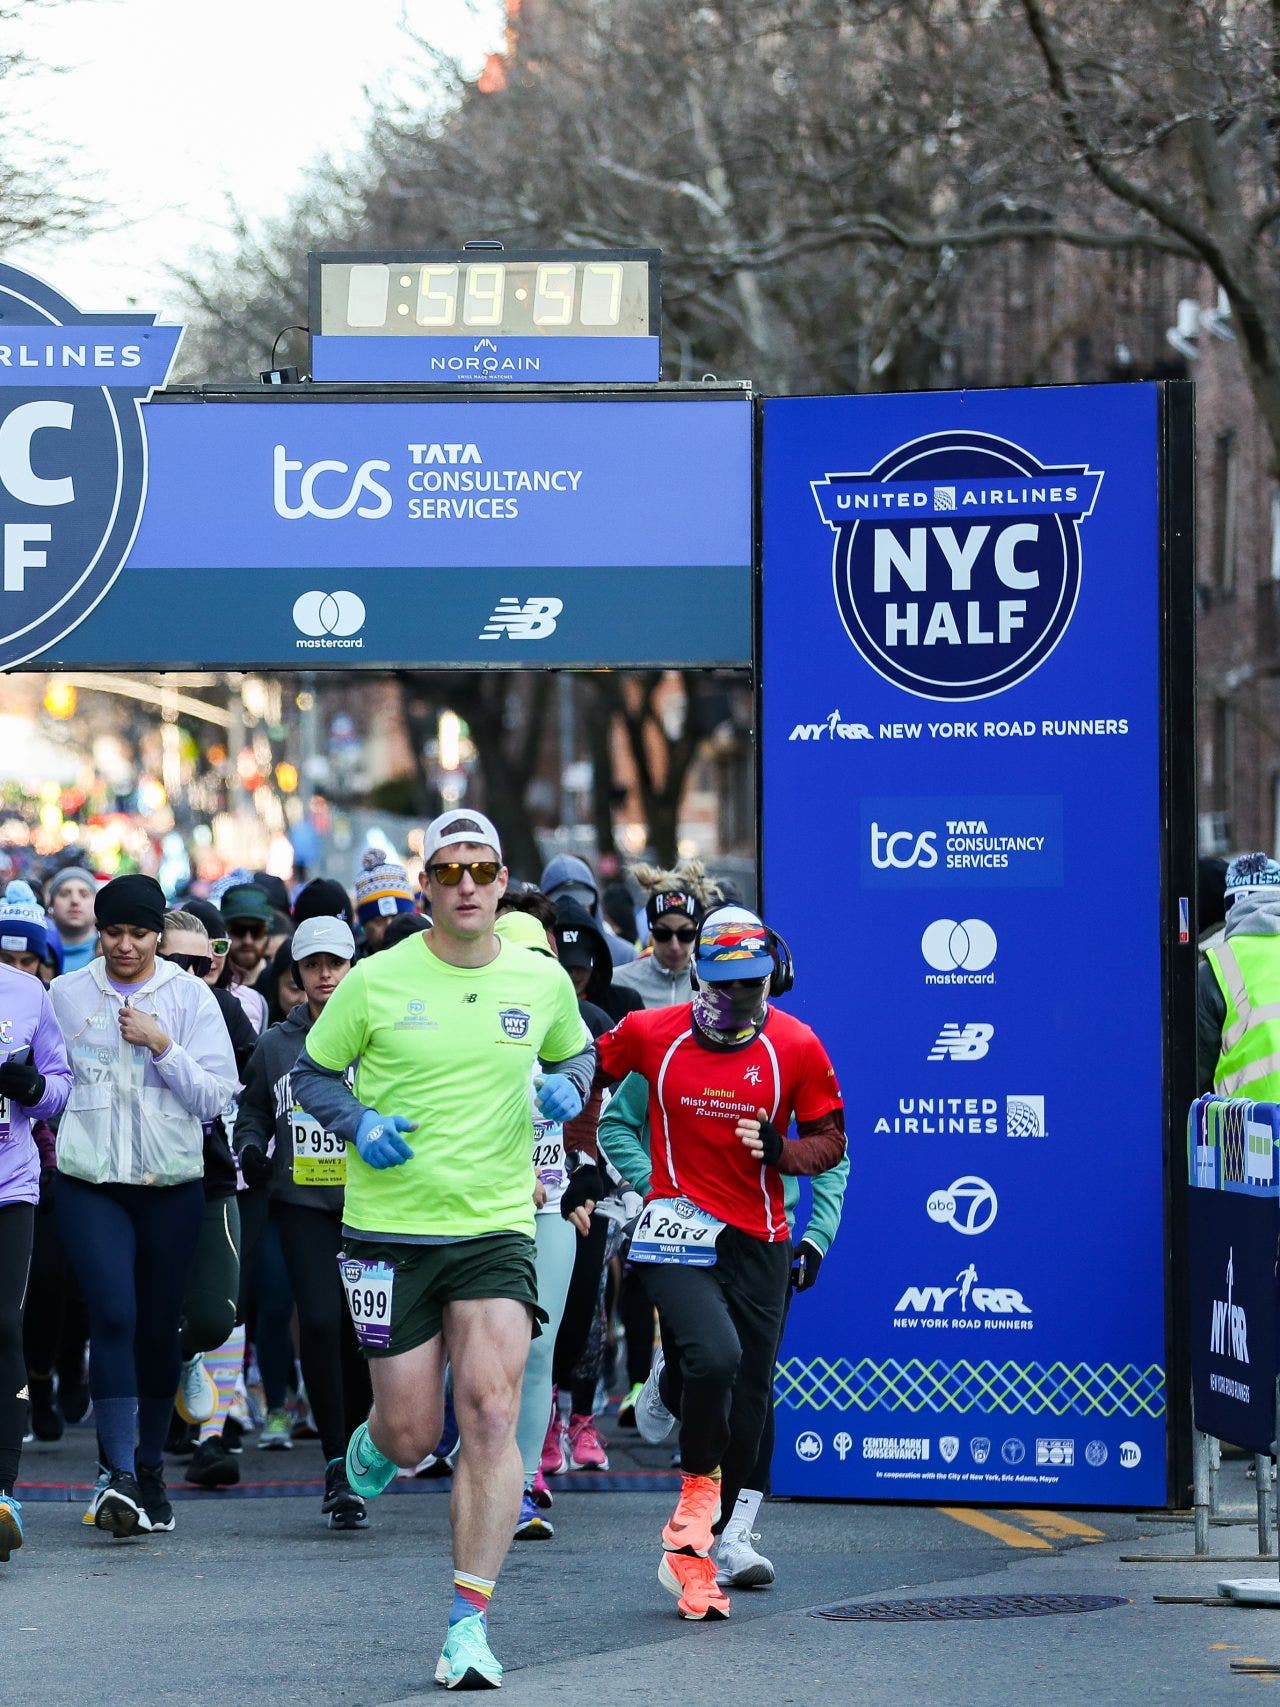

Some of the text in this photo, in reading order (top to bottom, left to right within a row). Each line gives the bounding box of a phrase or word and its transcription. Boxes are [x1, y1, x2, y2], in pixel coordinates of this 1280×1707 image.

[431, 357, 540, 371] NORQAIN
[407, 443, 482, 464] TATA
[274, 444, 393, 520] tcs
[407, 470, 583, 492] CONSULTANCY
[837, 487, 1078, 509] UNITED AIRLINES
[407, 498, 519, 519] SERVICES
[874, 523, 1040, 593] NYC
[885, 600, 1027, 647] HALF
[879, 723, 922, 739] NEW
[928, 722, 978, 738] YORK
[984, 721, 1036, 737] ROAD
[1042, 719, 1129, 736] RUNNERS
[946, 820, 988, 834] TATA
[871, 822, 938, 869] tcs
[946, 836, 1045, 851] CONSULTANCY
[946, 854, 1009, 868] SERVICES
[562, 930, 579, 943] EY
[504, 1017, 526, 1028] NYC
[506, 1026, 524, 1034] HALF
[702, 1087, 735, 1099] Jianhui
[680, 1096, 755, 1112] Misty Mountain
[899, 1098, 998, 1114] UNITED
[695, 1108, 740, 1119] Runners
[874, 1118, 998, 1134] AIRLINES
[295, 1126, 307, 1143] D
[928, 1199, 954, 1212] abc
[639, 1211, 652, 1229] A
[659, 1244, 680, 1253] WAVE
[345, 1267, 360, 1275] NYC
[894, 1318, 1033, 1330] NEW YORK ROAD RUNNERS
[862, 1437, 922, 1450] CENTRAL PARK
[862, 1448, 922, 1460] CONSERVANCY
[1120, 1449, 1138, 1461] MTA
